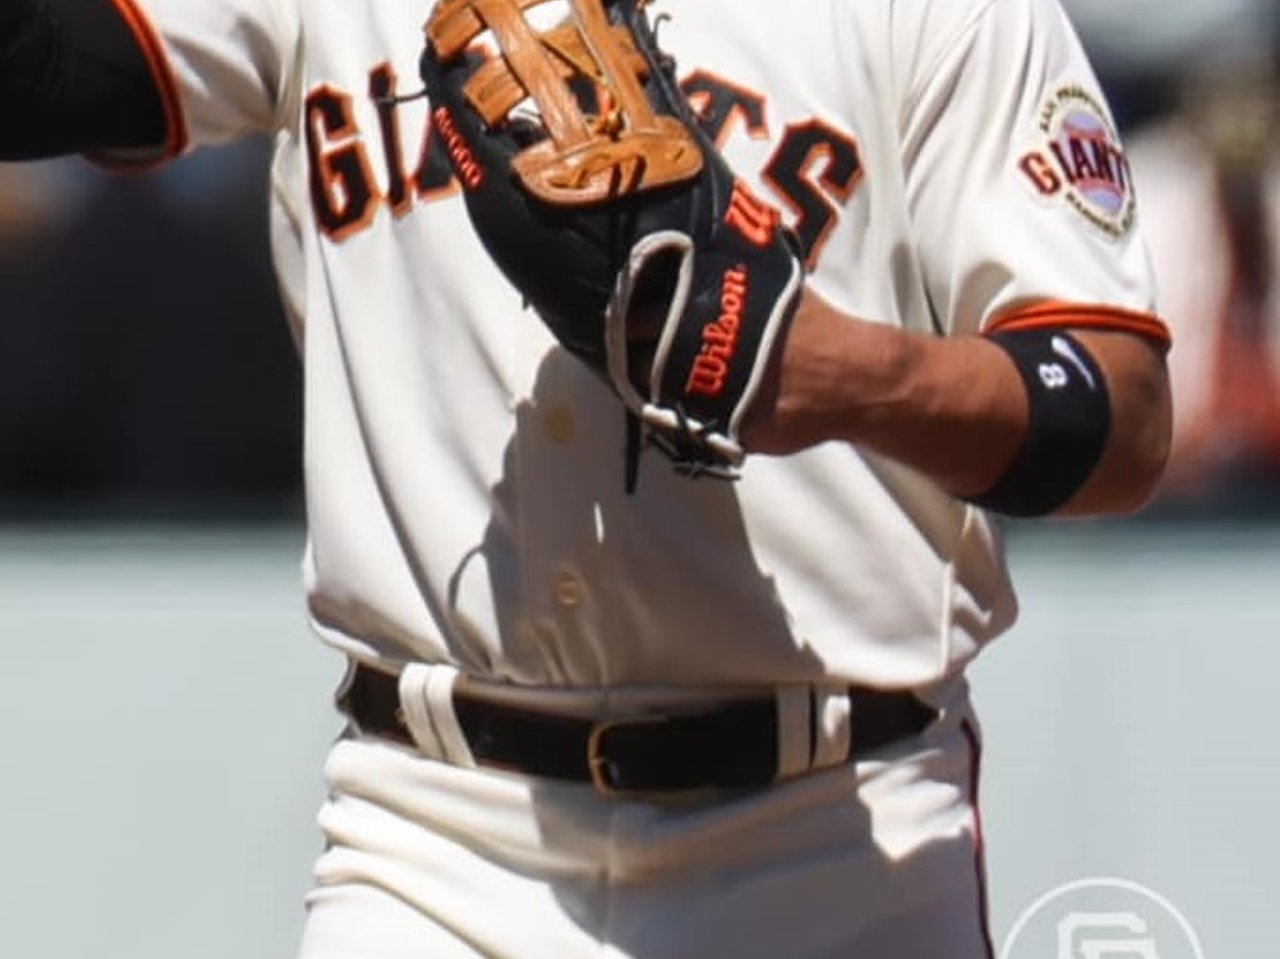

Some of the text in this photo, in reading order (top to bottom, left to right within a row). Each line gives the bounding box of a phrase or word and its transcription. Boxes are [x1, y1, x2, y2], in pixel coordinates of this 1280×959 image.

[1017, 135, 1128, 197] GIANT
[685, 263, 747, 398] Wilson
[1039, 362, 1069, 389] 8
